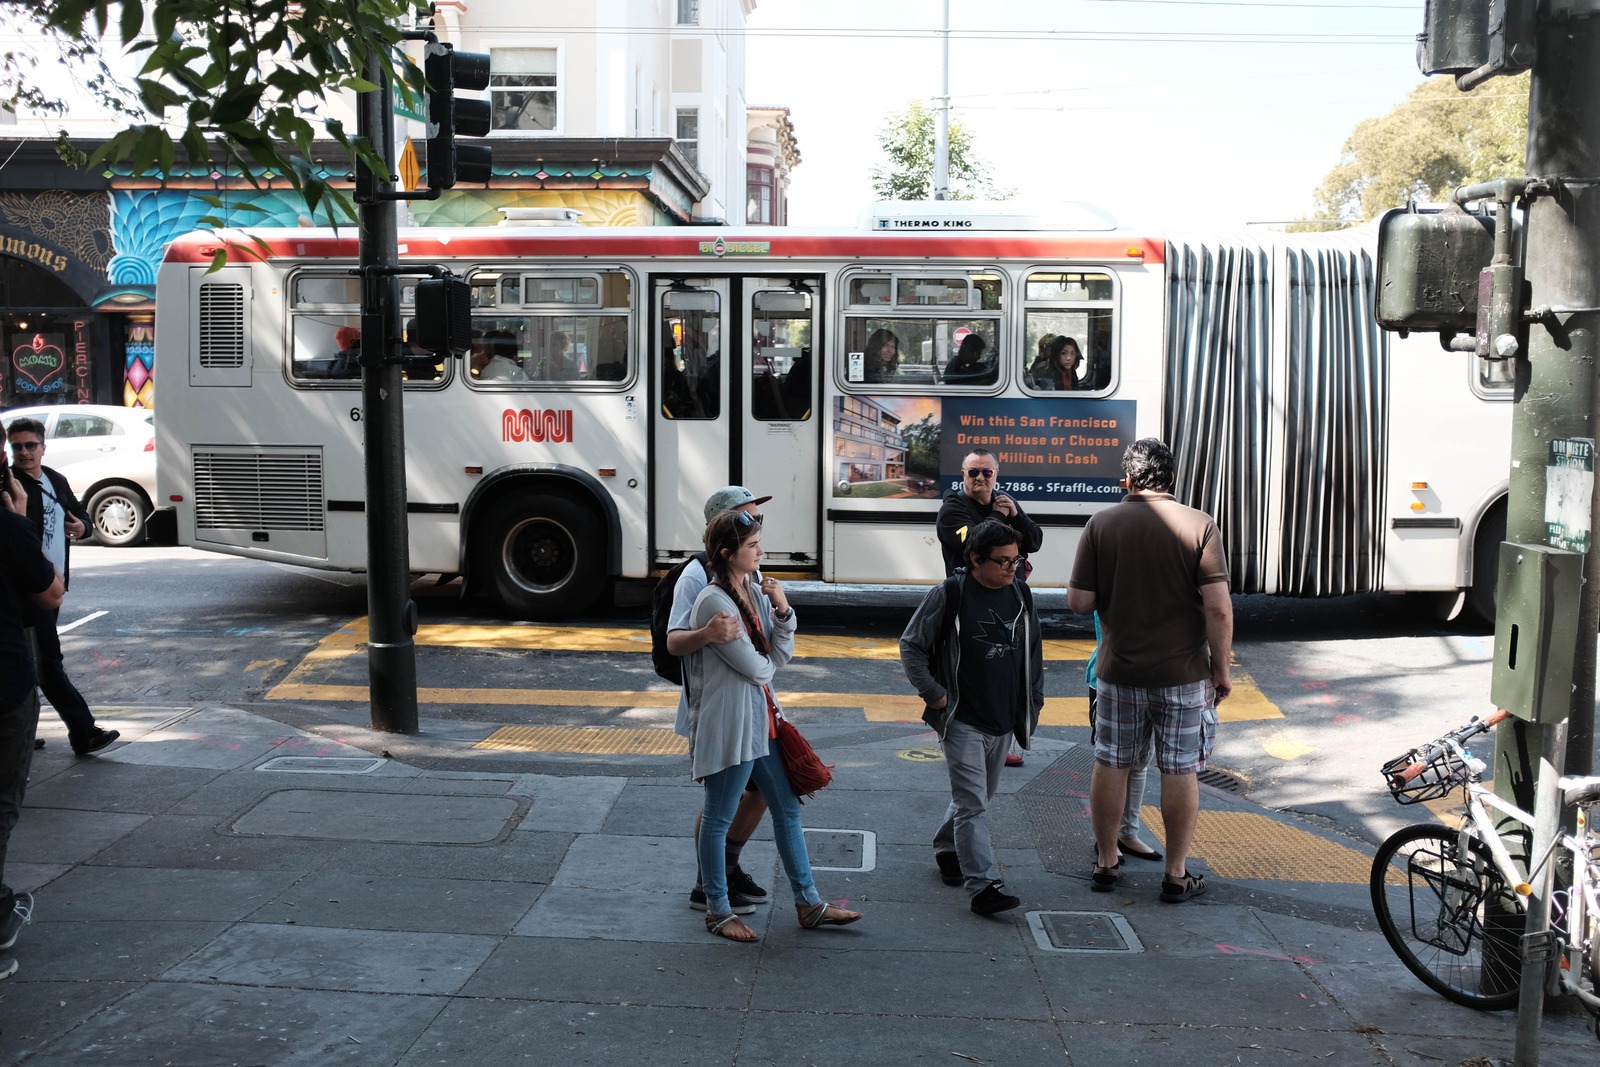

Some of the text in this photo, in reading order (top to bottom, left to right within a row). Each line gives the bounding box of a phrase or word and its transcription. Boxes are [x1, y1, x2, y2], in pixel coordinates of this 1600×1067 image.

[393, 92, 426, 117] Mani
[894, 220, 972, 228] THERMO KING
[15, 377, 39, 392] BODY
[42, 377, 64, 393] SHOP
[960, 415, 1117, 429] Win this San Francisco
[957, 433, 1119, 447] Dream House or Choose
[998, 452, 1099, 465] Million in Cash
[1046, 482, 1122, 494] SFraffle.com
